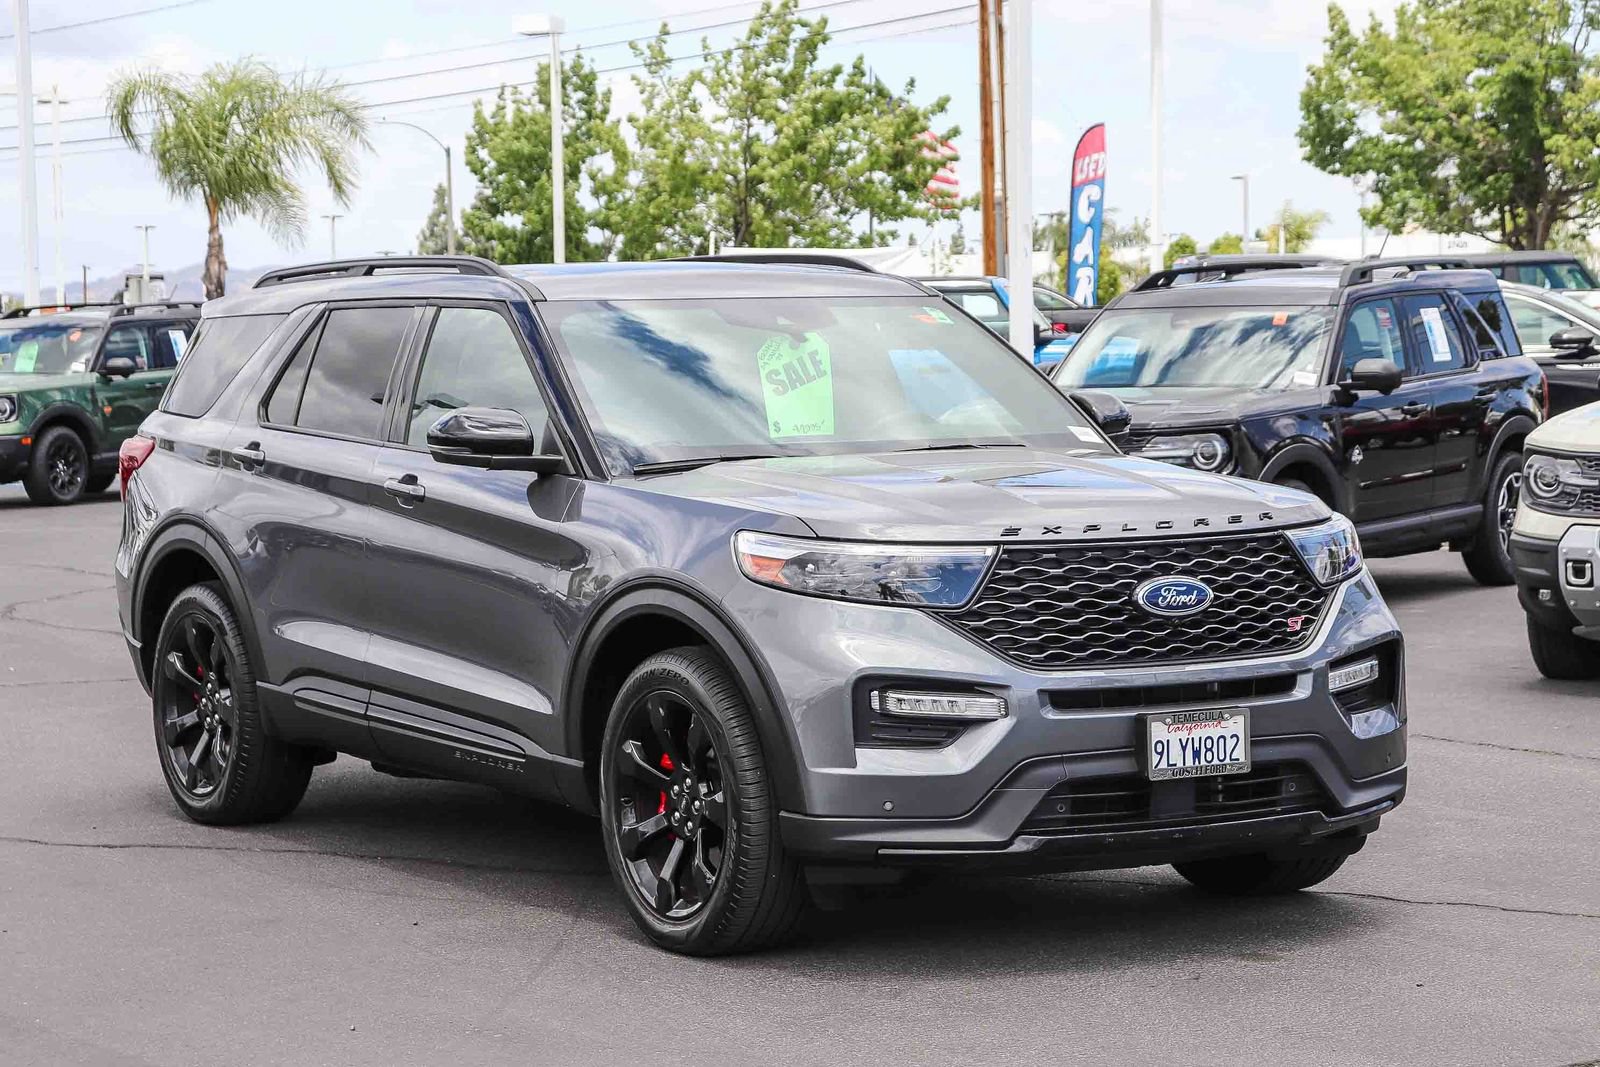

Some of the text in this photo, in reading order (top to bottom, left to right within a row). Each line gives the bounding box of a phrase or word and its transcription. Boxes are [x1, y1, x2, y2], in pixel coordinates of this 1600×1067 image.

[1075, 152, 1105, 181] USED
[765, 349, 827, 396] SALE
[1000, 511, 1274, 537] EXPLORER
[1158, 586, 1198, 607] Ford
[1287, 616, 1305, 631] ST
[659, 668, 690, 687] ZERO
[1172, 711, 1224, 723] TEMECULA
[1167, 720, 1229, 736] California
[1153, 733, 1240, 769] 9LYW802
